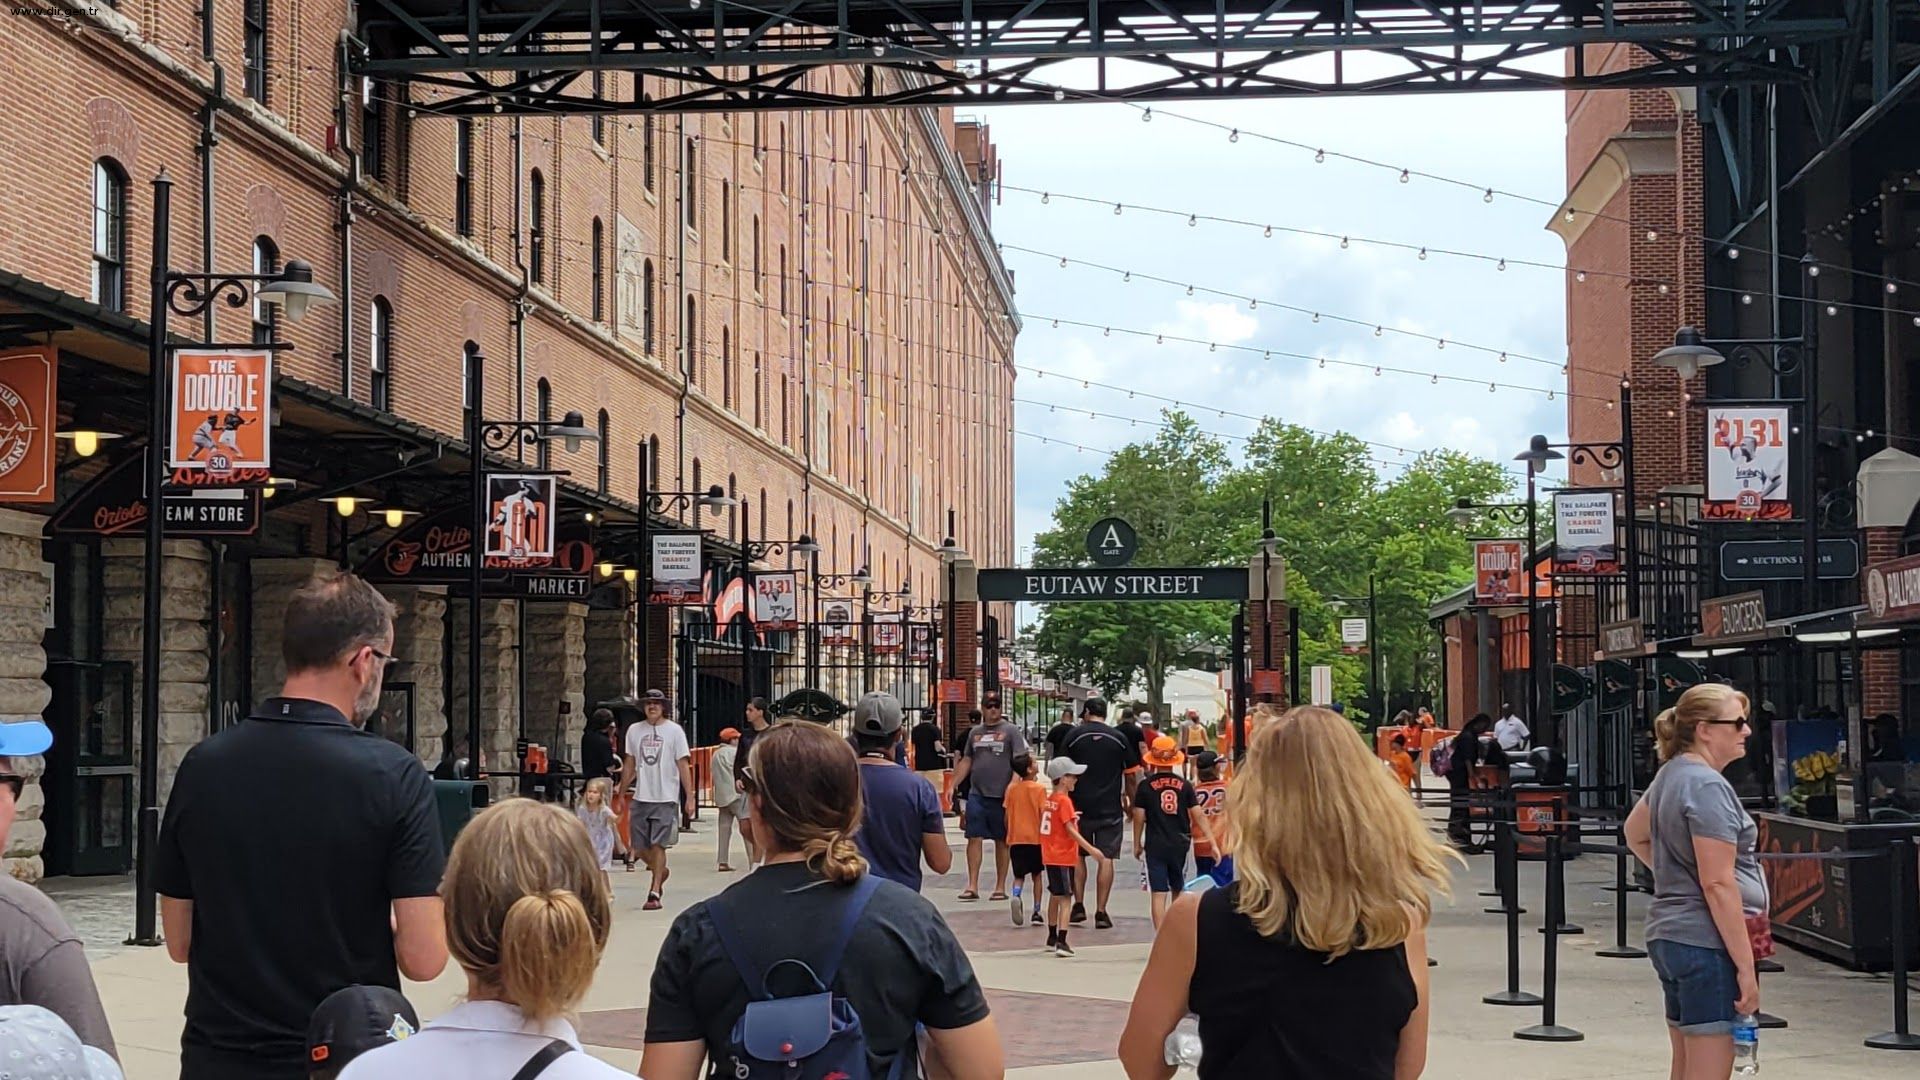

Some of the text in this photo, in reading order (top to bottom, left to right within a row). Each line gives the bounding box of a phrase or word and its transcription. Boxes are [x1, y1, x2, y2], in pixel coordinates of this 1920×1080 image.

[208, 360, 236, 373] THE
[184, 374, 258, 411] DOUBLE
[1714, 419, 1784, 447] 2131
[211, 457, 226, 468] 30
[1743, 495, 1755, 506] 30
[94, 501, 148, 534] Oriole
[163, 506, 245, 522] EAM STORE
[1100, 524, 1124, 548] A
[1480, 552, 1518, 570] DOUBLE
[1752, 556, 1797, 564] SECTIONS
[528, 579, 586, 595] MARKET
[759, 580, 793, 597] 2131
[1025, 576, 1204, 595] EUTAW STREET
[1721, 599, 1764, 634] BURGERS
[1160, 789, 1178, 815] 8
[1196, 787, 1226, 816] 23
